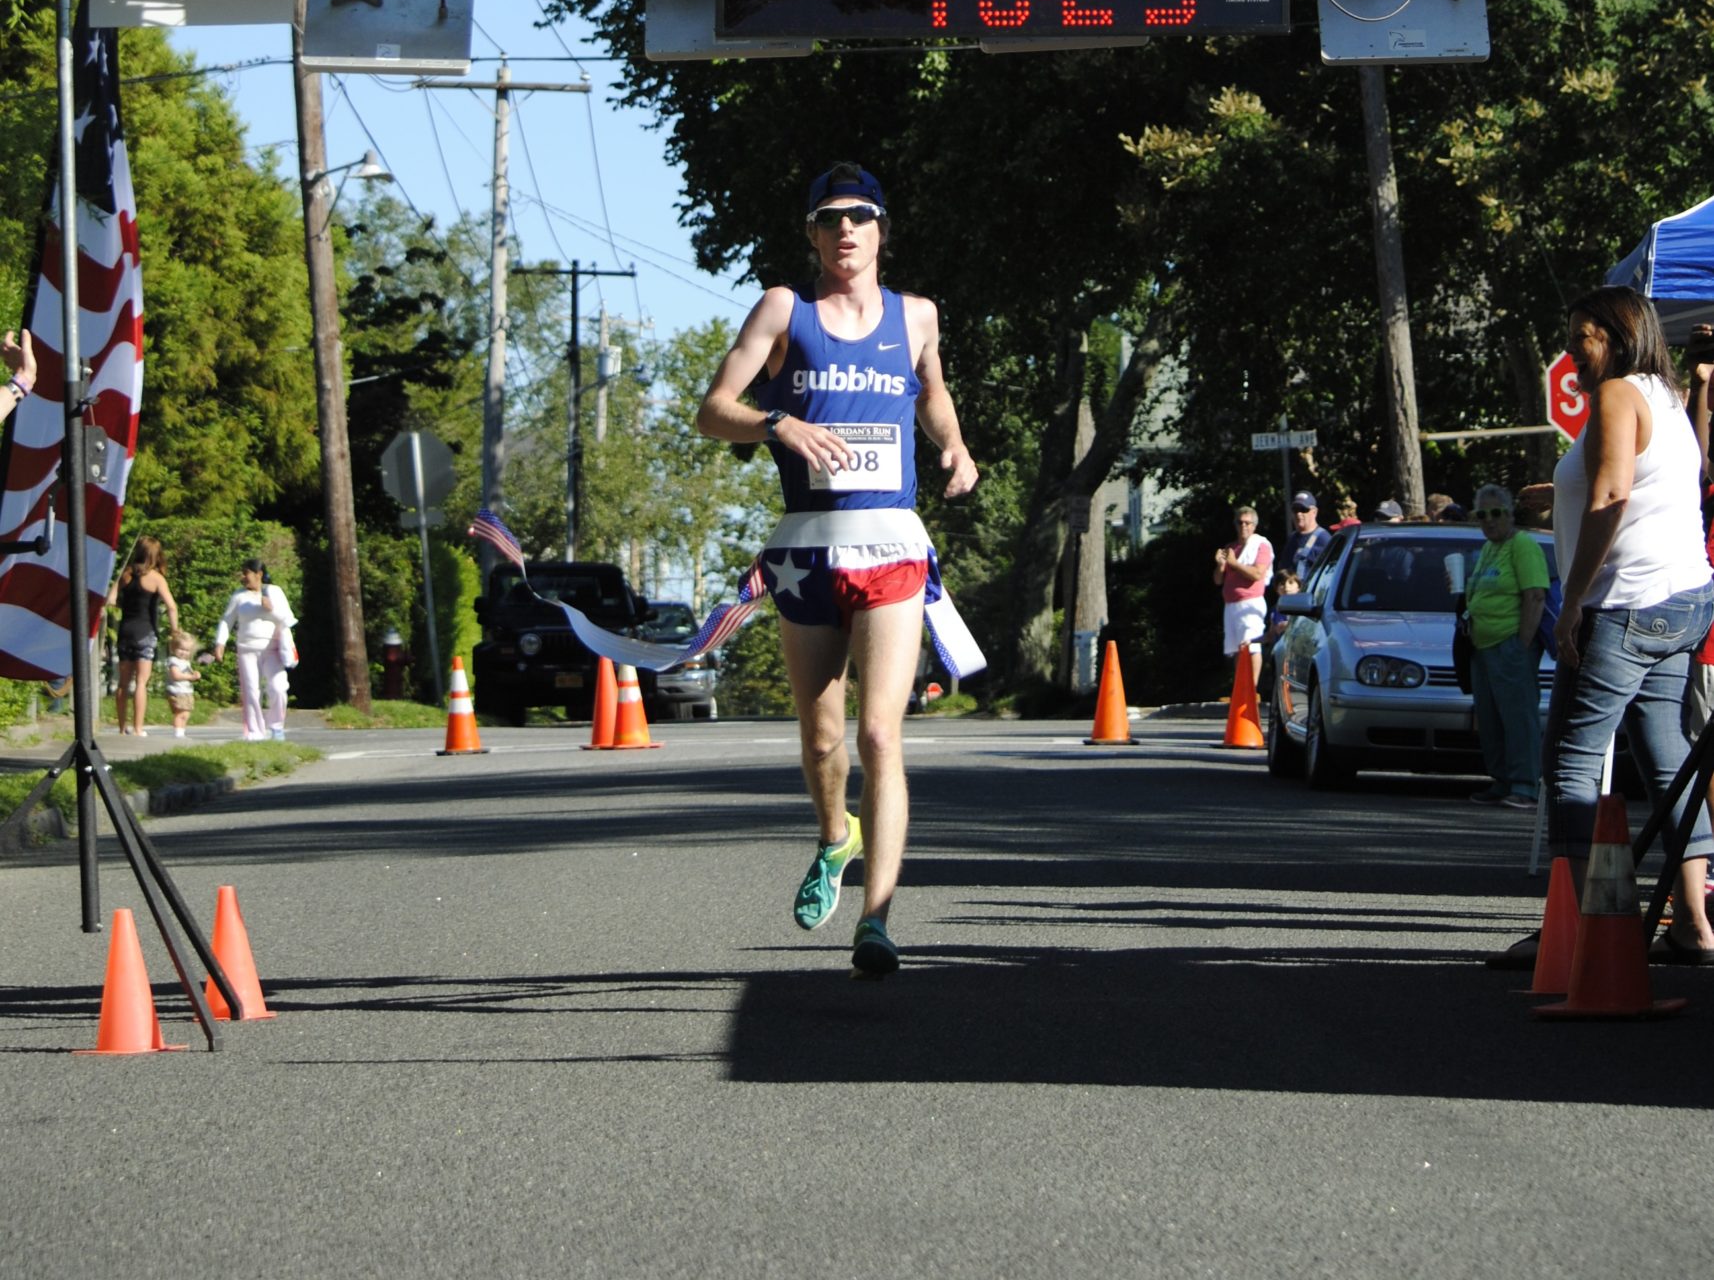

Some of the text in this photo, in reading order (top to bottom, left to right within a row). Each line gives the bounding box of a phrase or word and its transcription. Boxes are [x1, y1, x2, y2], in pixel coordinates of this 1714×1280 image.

[792, 363, 906, 395] gubbins
[830, 426, 891, 435] JORDAN'S RUN
[834, 450, 880, 472] 08
